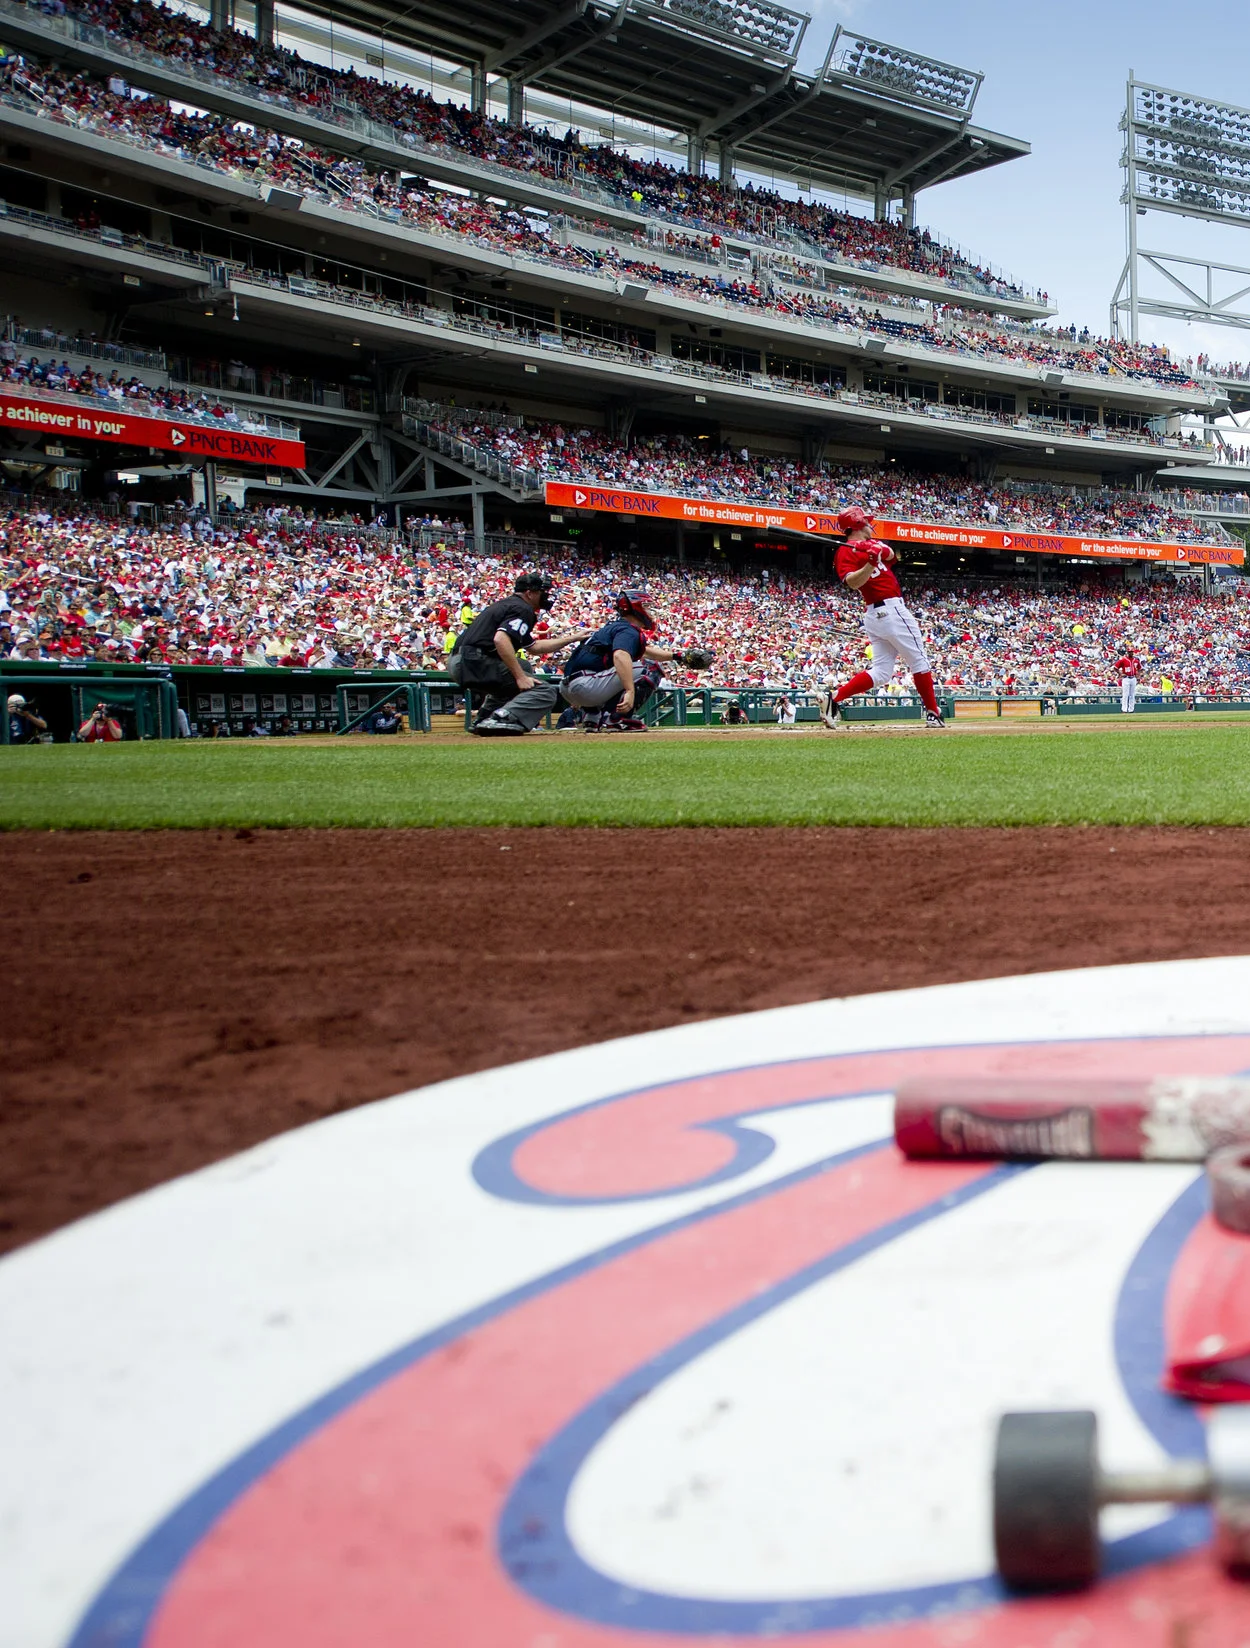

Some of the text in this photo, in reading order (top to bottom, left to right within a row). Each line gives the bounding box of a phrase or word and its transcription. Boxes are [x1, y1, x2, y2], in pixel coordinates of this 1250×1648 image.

[6, 406, 74, 428] achiever
[77, 415, 91, 430] in
[188, 431, 276, 459] PNC BANK
[590, 491, 661, 513] PNC BANK
[683, 503, 698, 516] for
[699, 505, 714, 518] the
[716, 508, 754, 521] achiever
[756, 511, 764, 523] in
[897, 526, 909, 537] for
[910, 527, 924, 538] the
[924, 529, 958, 542] achiever
[959, 532, 967, 542] in
[1014, 536, 1065, 551] PNC BANK
[1081, 542, 1092, 552] for
[1093, 543, 1105, 554] the
[1106, 545, 1137, 555] achiever
[1187, 549, 1234, 562] PNC BANK
